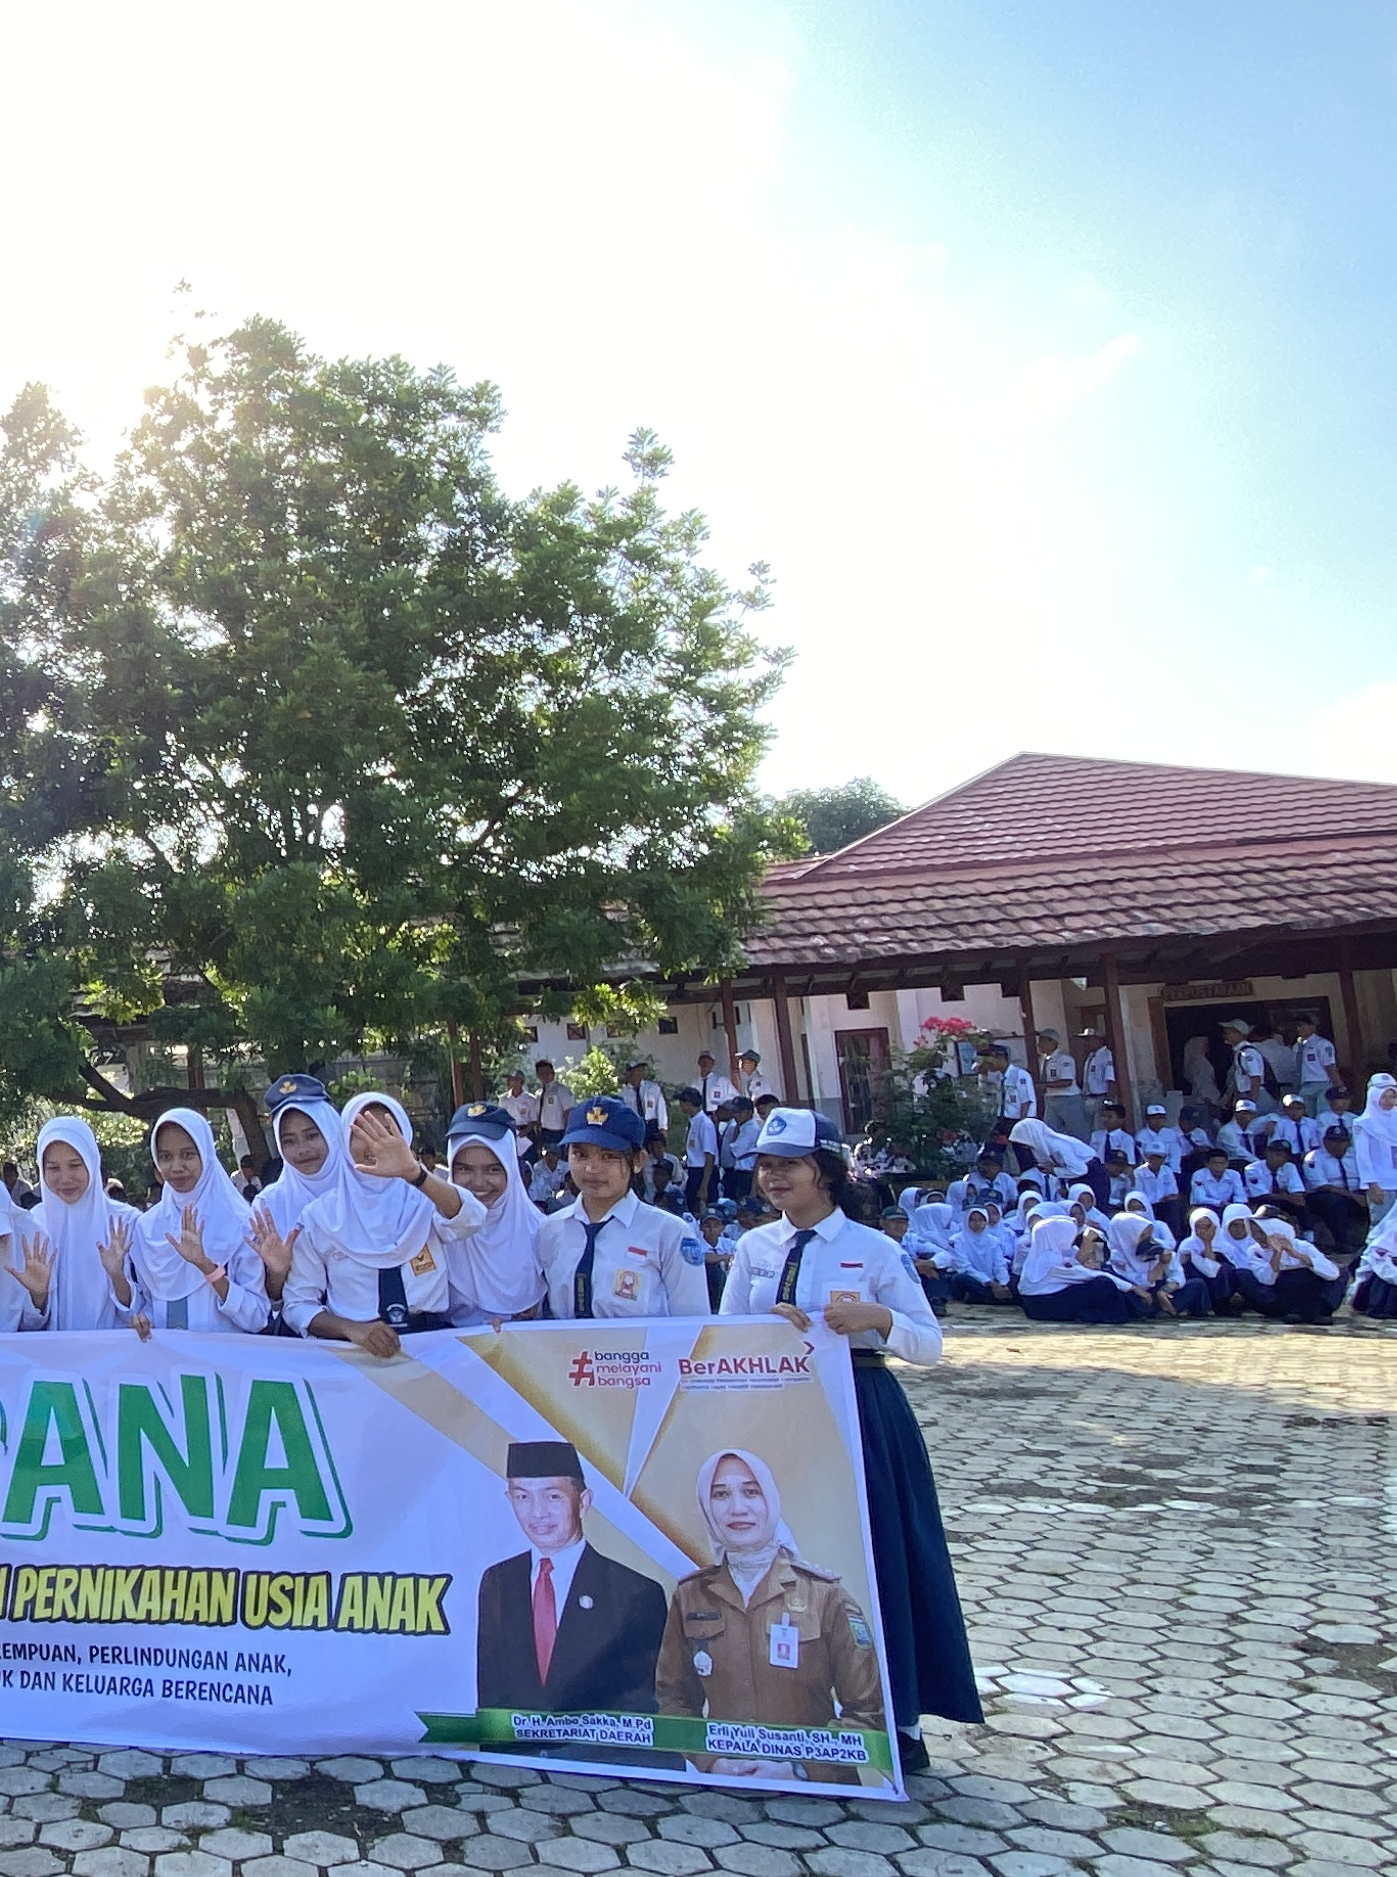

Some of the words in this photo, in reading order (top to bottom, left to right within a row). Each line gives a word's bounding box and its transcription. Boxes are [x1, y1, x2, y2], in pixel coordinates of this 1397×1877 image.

[594, 1350, 649, 1365] bangga
[678, 1354, 811, 1376] BerAKHLAK
[596, 1361, 662, 1377] melayani
[597, 1374, 651, 1389] bangsa
[9, 1564, 240, 1627] PERNIKAHAN
[241, 1571, 333, 1631] USIA
[334, 1572, 452, 1635] ANAK
[89, 1645, 229, 1672] PERLINDUNGAN
[234, 1652, 293, 1677] ANAK,
[20, 1671, 56, 1692] DAN
[62, 1673, 154, 1698] KELUARGA
[162, 1680, 274, 1706] BERENCANA
[513, 1715, 529, 1727] Dr.
[532, 1717, 544, 1727] H.
[547, 1715, 579, 1727] Ambo
[582, 1715, 619, 1729] Sakka,
[622, 1717, 651, 1731] M.Pd
[516, 1728, 596, 1739] SEKRETARIAT
[599, 1730, 651, 1744] DAERAH
[841, 1734, 862, 1746] MH
[708, 1738, 759, 1753] KEPALA
[762, 1743, 802, 1756] DINAS
[805, 1745, 866, 1761] P3AP2KB
